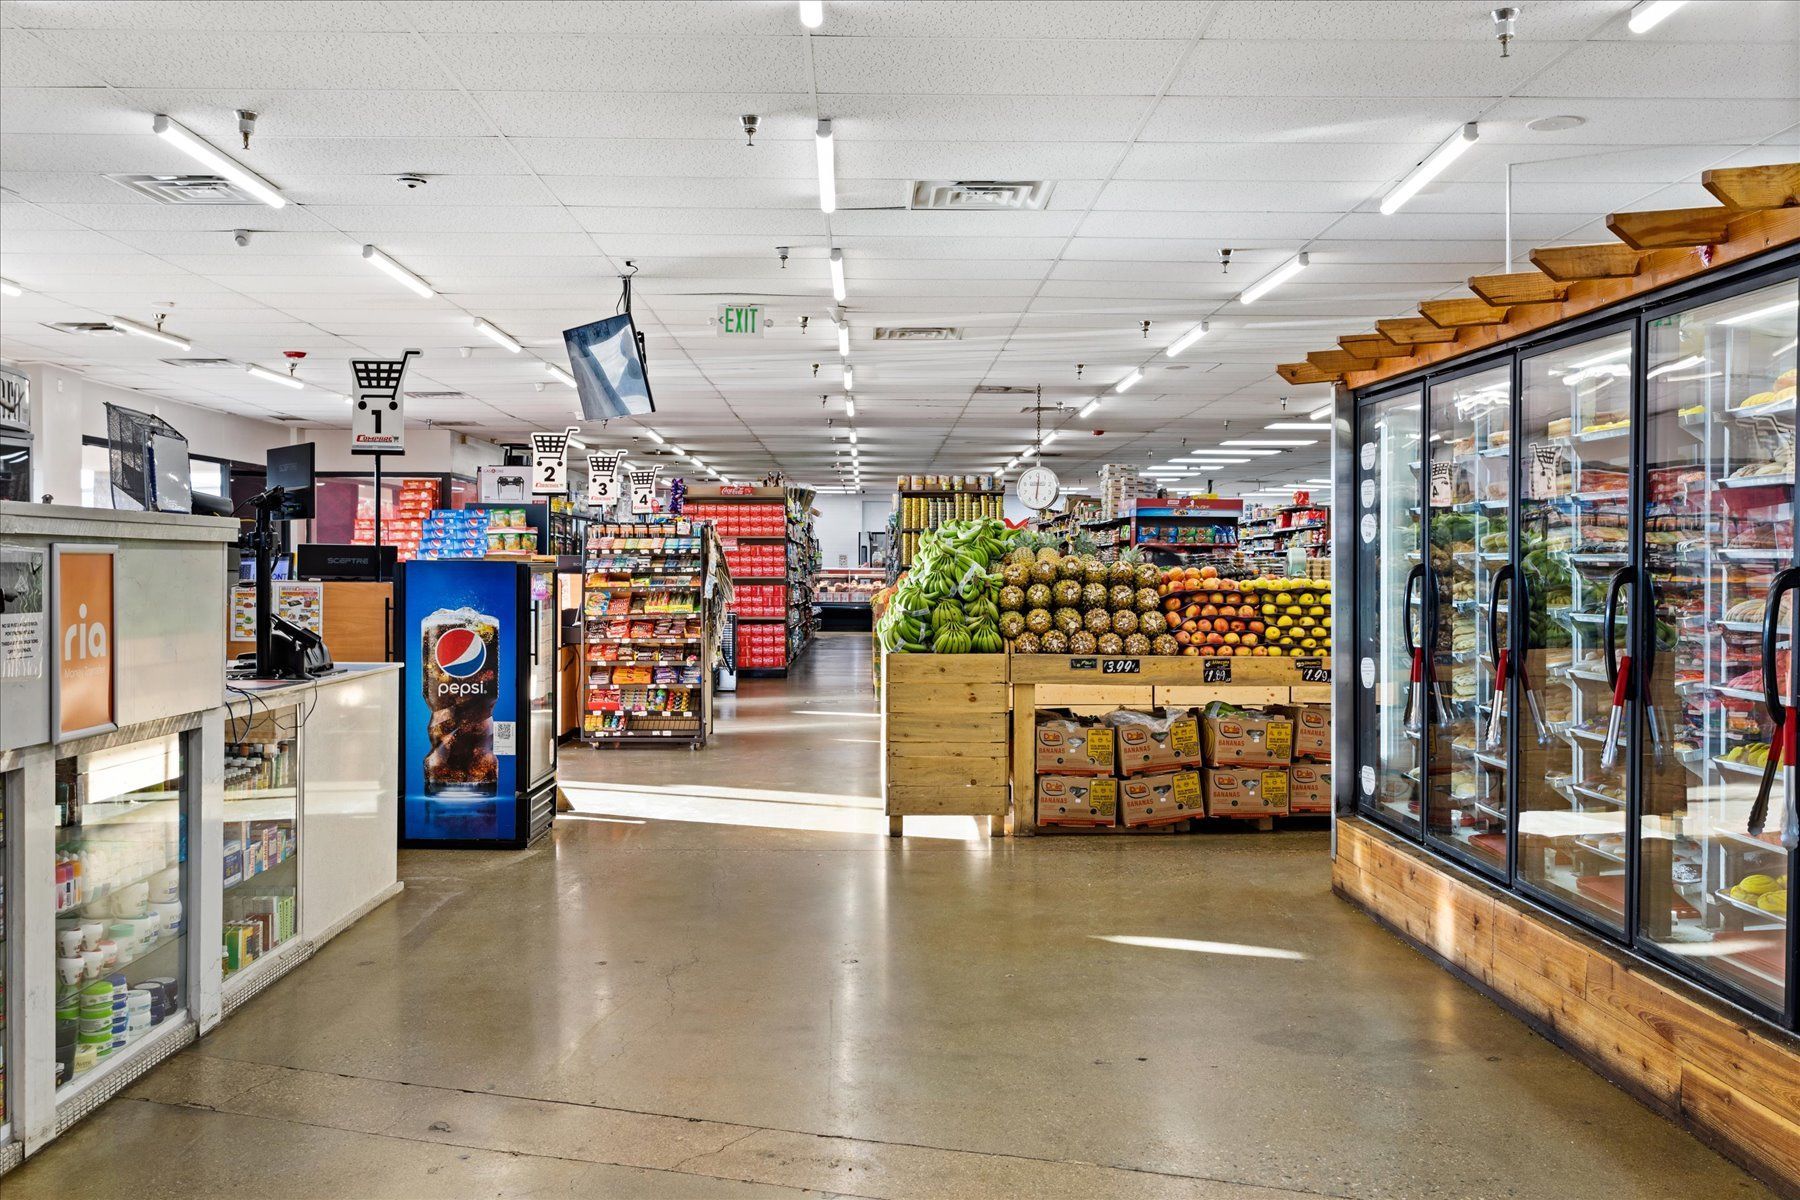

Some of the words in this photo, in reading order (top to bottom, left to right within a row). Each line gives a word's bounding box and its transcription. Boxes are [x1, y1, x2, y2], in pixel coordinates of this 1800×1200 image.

[725, 307, 758, 333] EXIT
[371, 409, 382, 434] 1
[544, 466, 556, 482] 2
[598, 483, 608, 496] 3
[639, 494, 648, 506] 4
[327, 556, 370, 566] SCEPTRE
[64, 603, 107, 661] ria
[438, 680, 484, 697] pepsi
[1124, 745, 1151, 753] BANANAS
[1127, 799, 1154, 807] BANANAS
